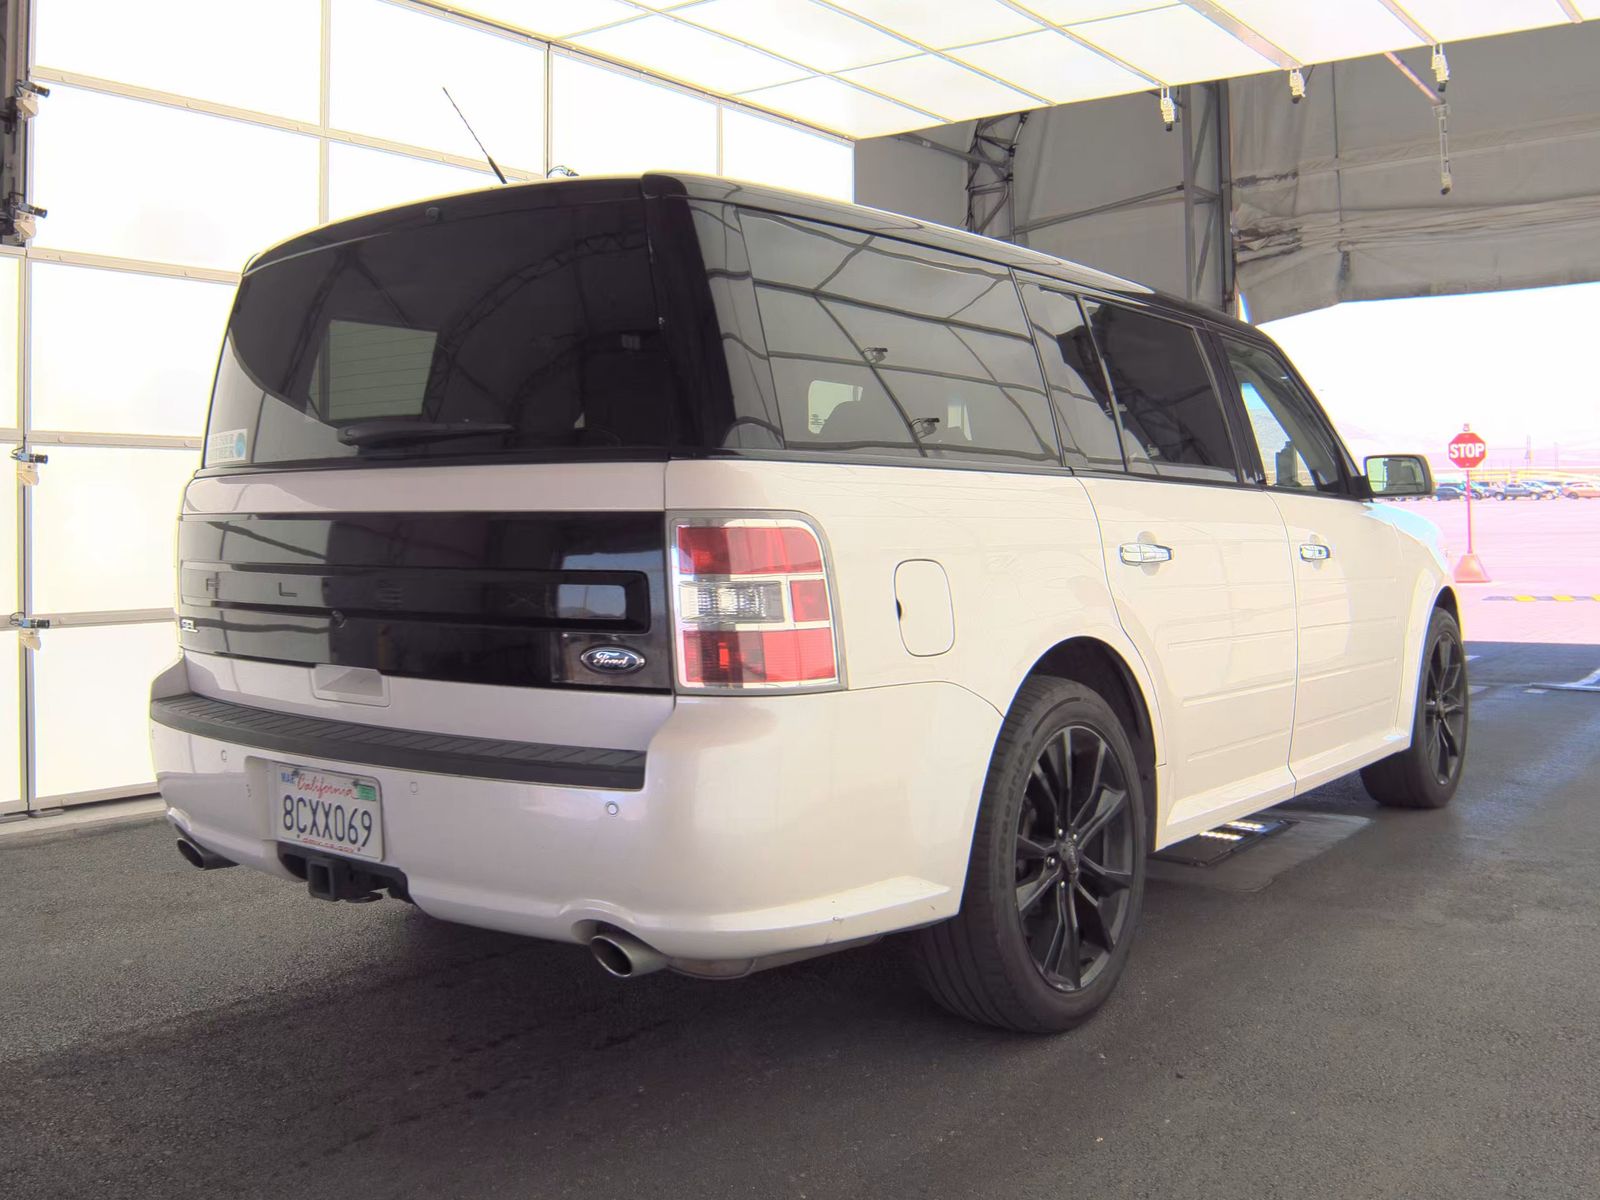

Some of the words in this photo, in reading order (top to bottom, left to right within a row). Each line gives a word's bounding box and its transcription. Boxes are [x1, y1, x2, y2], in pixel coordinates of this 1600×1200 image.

[1449, 443, 1485, 459] STOP
[593, 651, 629, 665] Ford
[296, 773, 360, 800] California
[283, 794, 372, 848] 8CXX069
